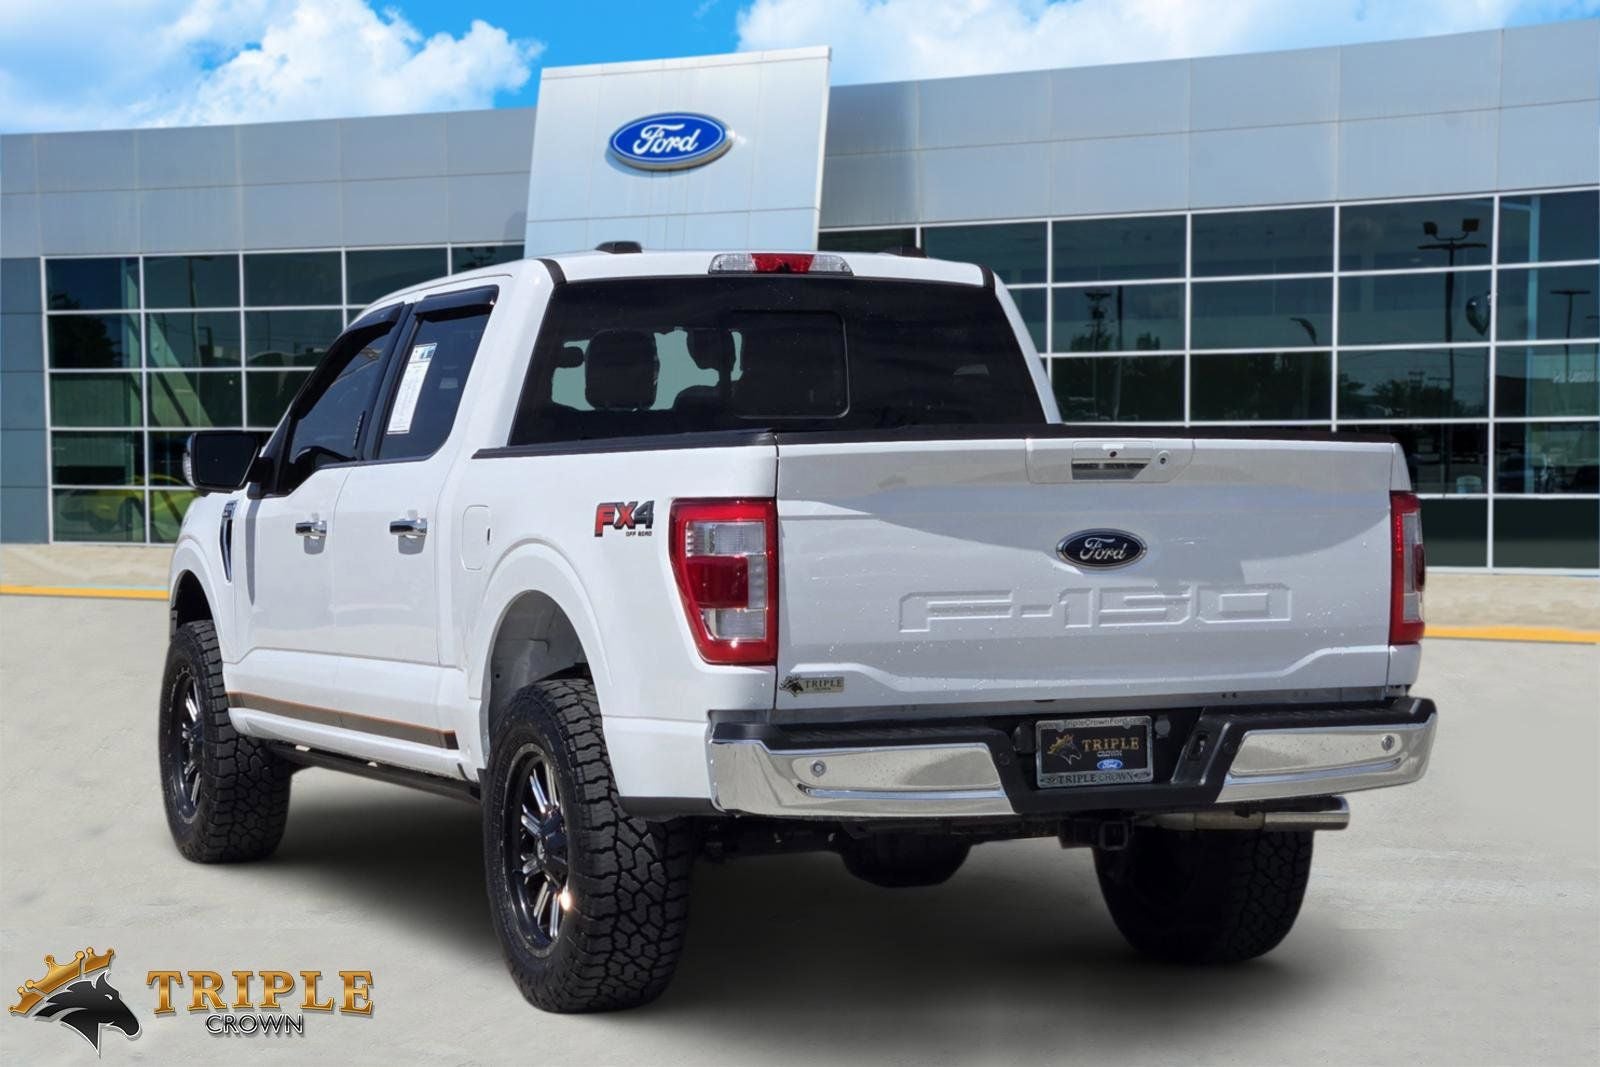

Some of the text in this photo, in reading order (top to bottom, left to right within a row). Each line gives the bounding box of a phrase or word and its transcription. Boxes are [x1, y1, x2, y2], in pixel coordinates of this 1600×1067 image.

[632, 123, 702, 155] Ford
[594, 500, 655, 537] FX4
[1079, 537, 1128, 560] Ford
[899, 583, 1292, 632] F-150
[805, 679, 844, 689] TRIPLE
[1081, 736, 1140, 752] TRIPLE
[1057, 773, 1097, 785] TRIPLE
